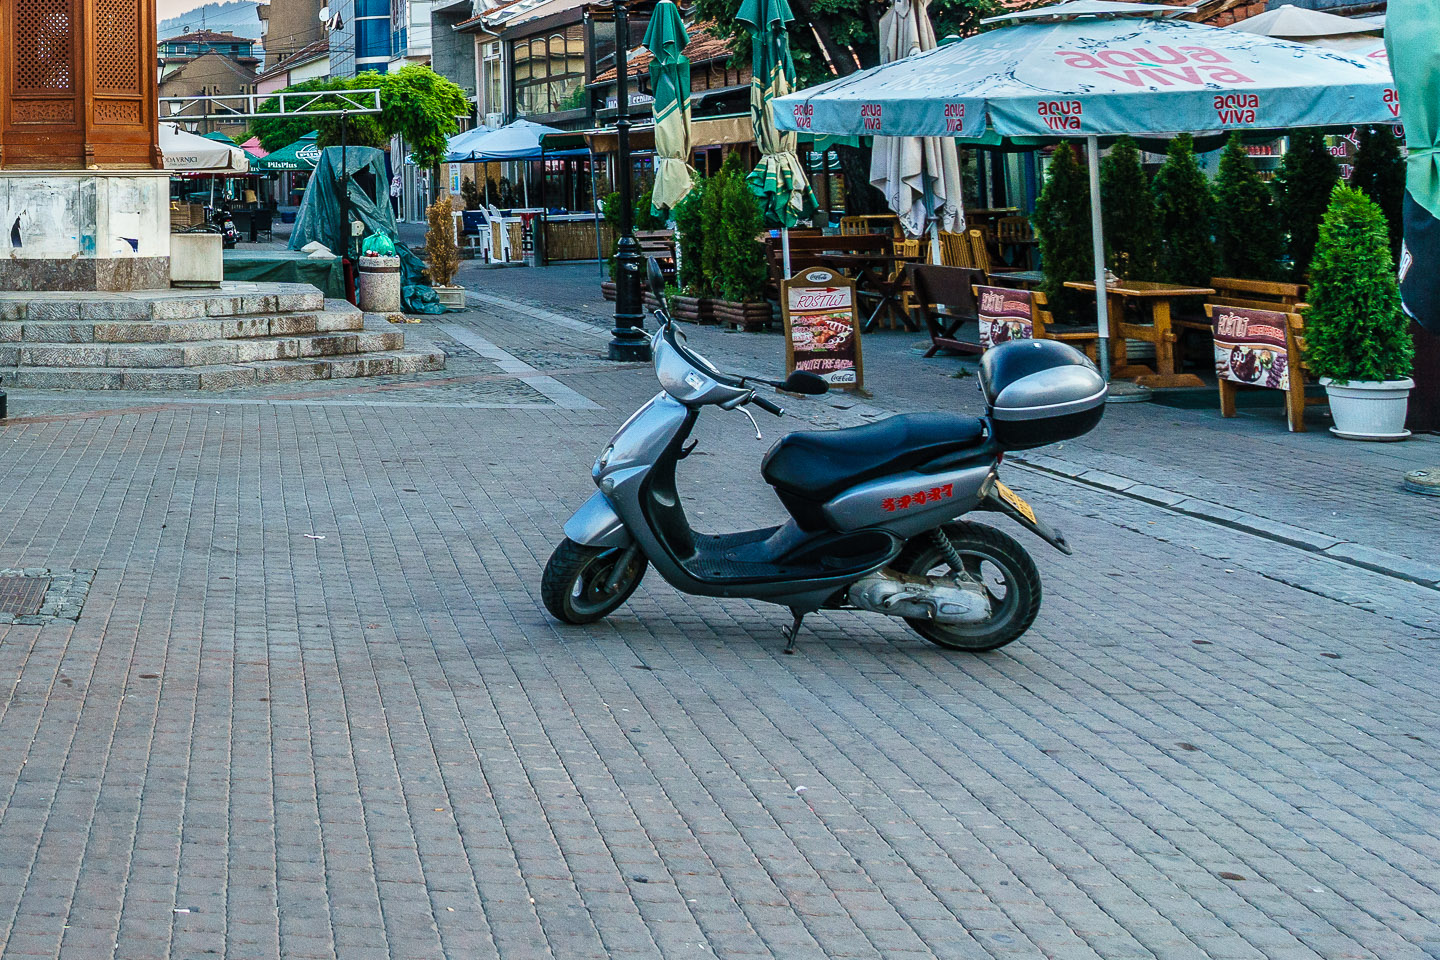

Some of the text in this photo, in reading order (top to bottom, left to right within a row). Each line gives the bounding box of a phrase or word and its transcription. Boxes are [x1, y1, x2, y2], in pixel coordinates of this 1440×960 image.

[1054, 45, 1233, 69] aqua
[1095, 65, 1256, 87] viva
[1037, 100, 1082, 116] aqua
[1213, 94, 1259, 110] aqua
[793, 103, 814, 117] aqua
[861, 104, 882, 118] aqua
[944, 103, 965, 118] aqua
[1217, 109, 1256, 125] viva
[795, 116, 811, 128] viva
[863, 117, 881, 130] viva
[946, 117, 963, 132] viva
[1043, 115, 1081, 130] viva
[175, 156, 198, 164] VRNJCI
[797, 292, 846, 308] ROŠTILJ
[880, 483, 954, 512] SPORT
